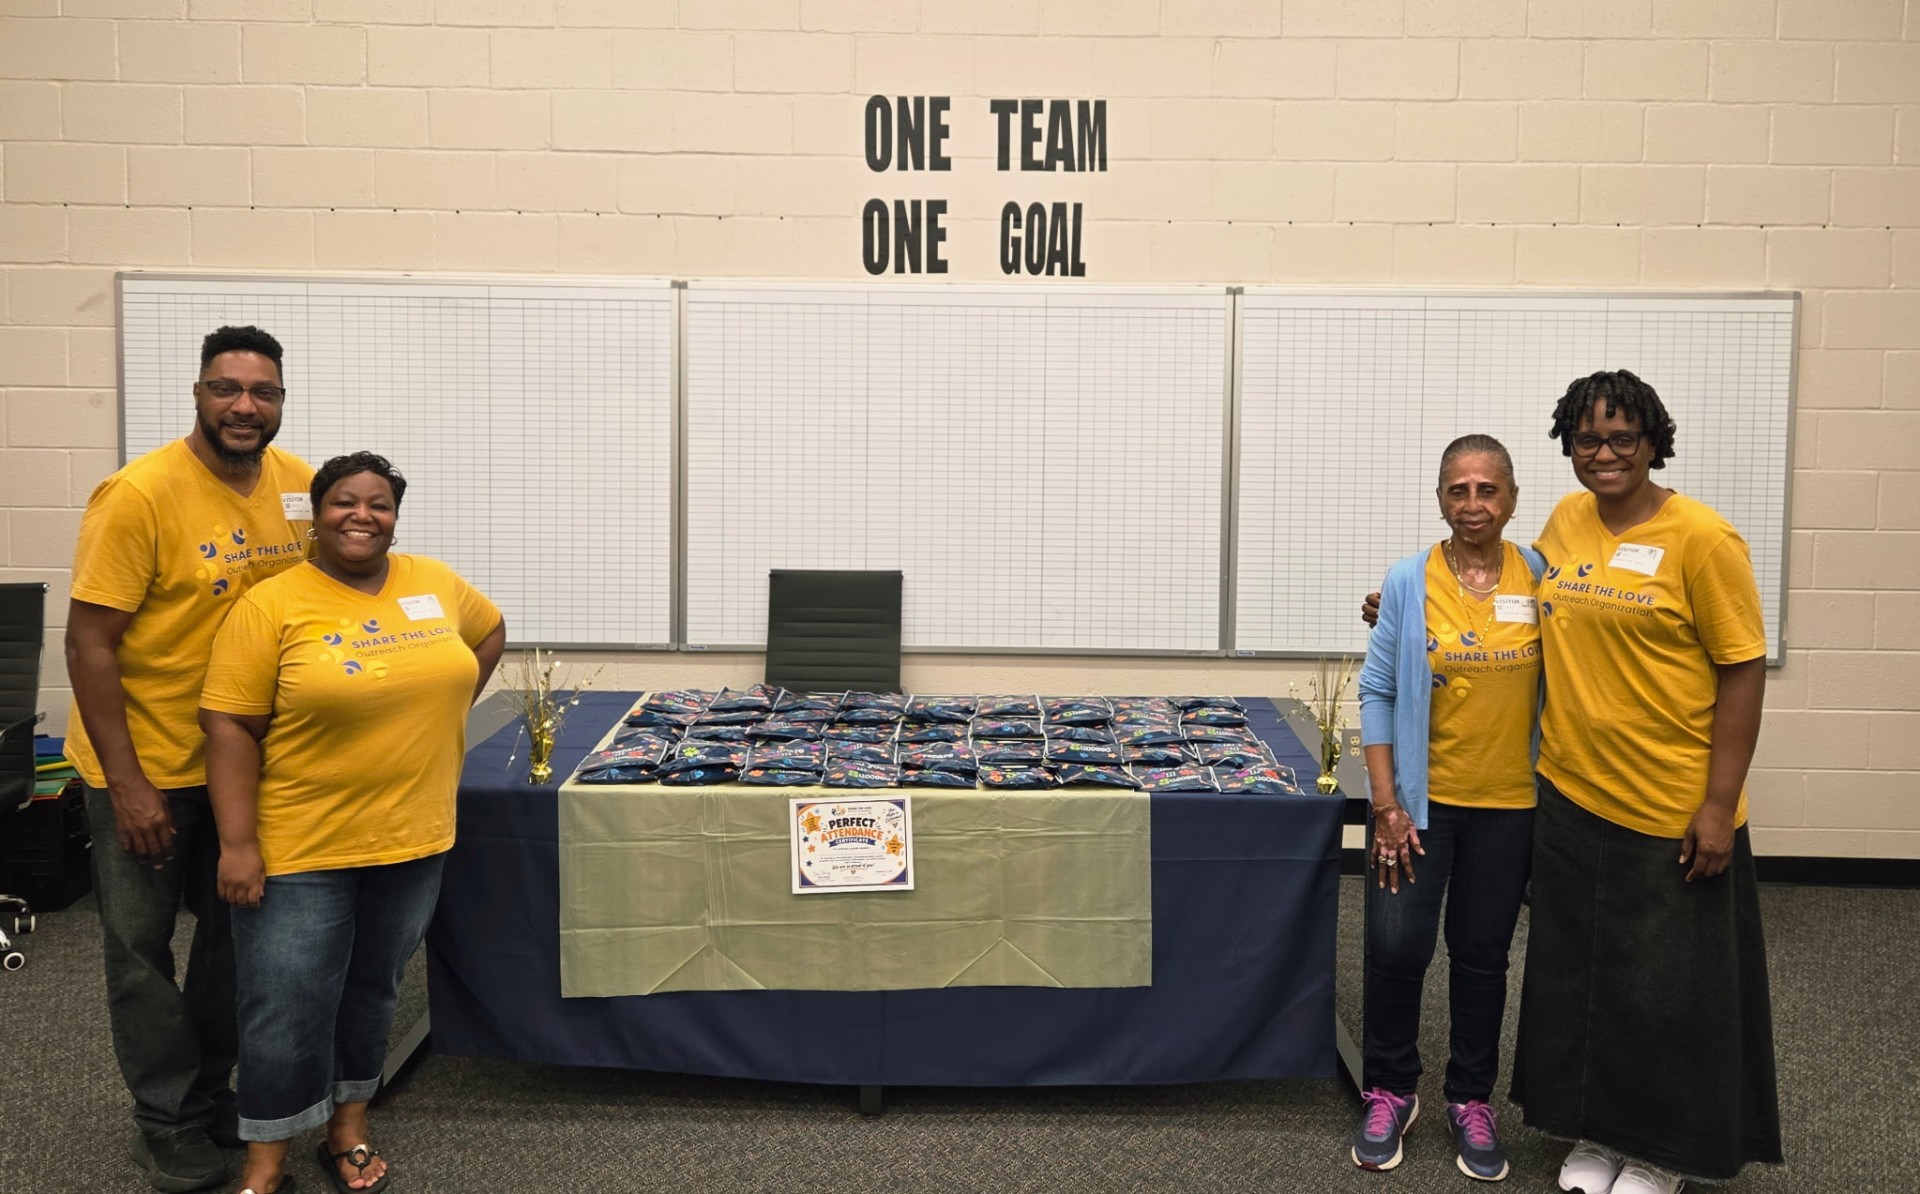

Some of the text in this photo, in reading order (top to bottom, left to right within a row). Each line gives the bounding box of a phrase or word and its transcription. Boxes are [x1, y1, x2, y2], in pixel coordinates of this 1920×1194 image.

[865, 95, 1107, 172] ONE TEAM
[862, 198, 1086, 277] ONE GOAL
[256, 545, 279, 557] THE
[1557, 580, 1655, 606] SHARE THE LOVE
[1552, 592, 1654, 618] Outreach Organization
[352, 634, 398, 649] SHARE
[400, 630, 426, 642] THE
[355, 645, 406, 659] Outreach
[1445, 646, 1543, 662] SHARE THE LOV
[1444, 664, 1492, 673] Outreach
[828, 817, 876, 830] PERFECT
[820, 827, 884, 843] ATTENDANCE
